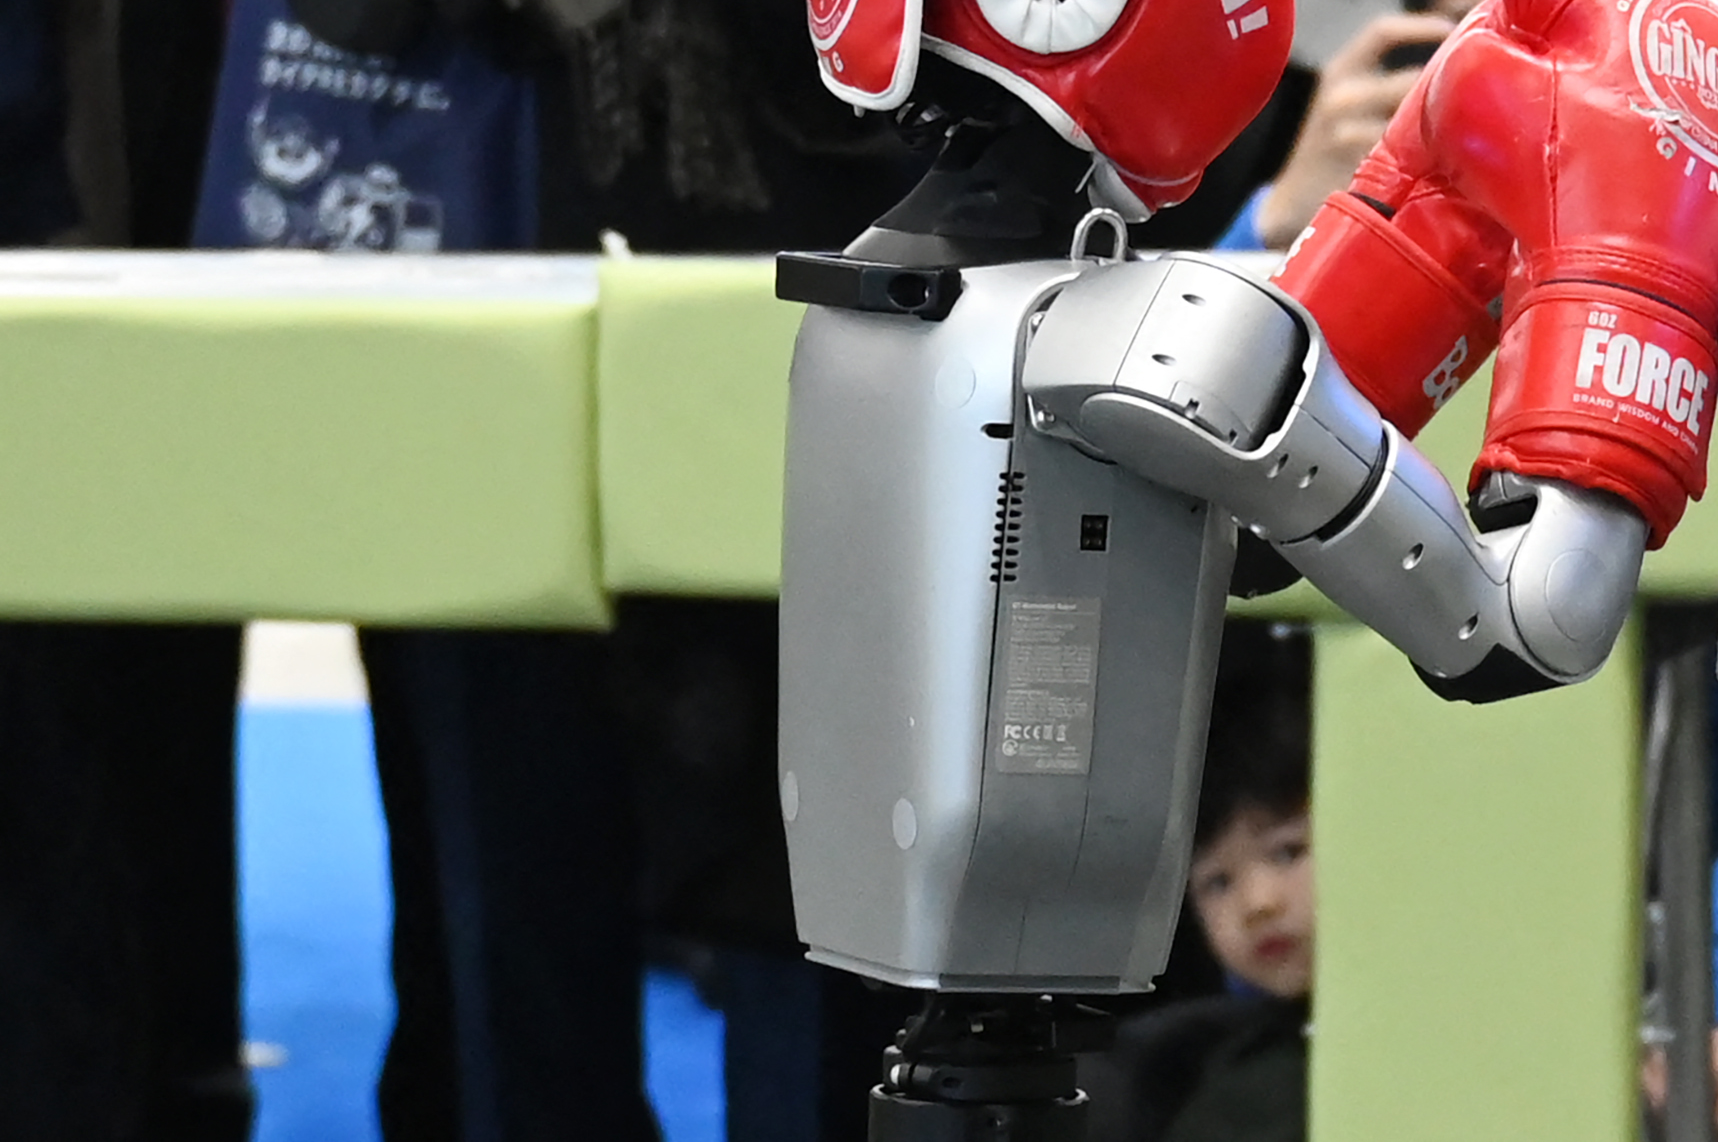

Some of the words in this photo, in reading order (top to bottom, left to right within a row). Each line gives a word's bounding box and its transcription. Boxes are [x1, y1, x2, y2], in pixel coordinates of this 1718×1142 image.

[1572, 393, 1615, 409] BRAND
[1618, 401, 1660, 426] WISDOM
[1575, 327, 1709, 437] FORCE
